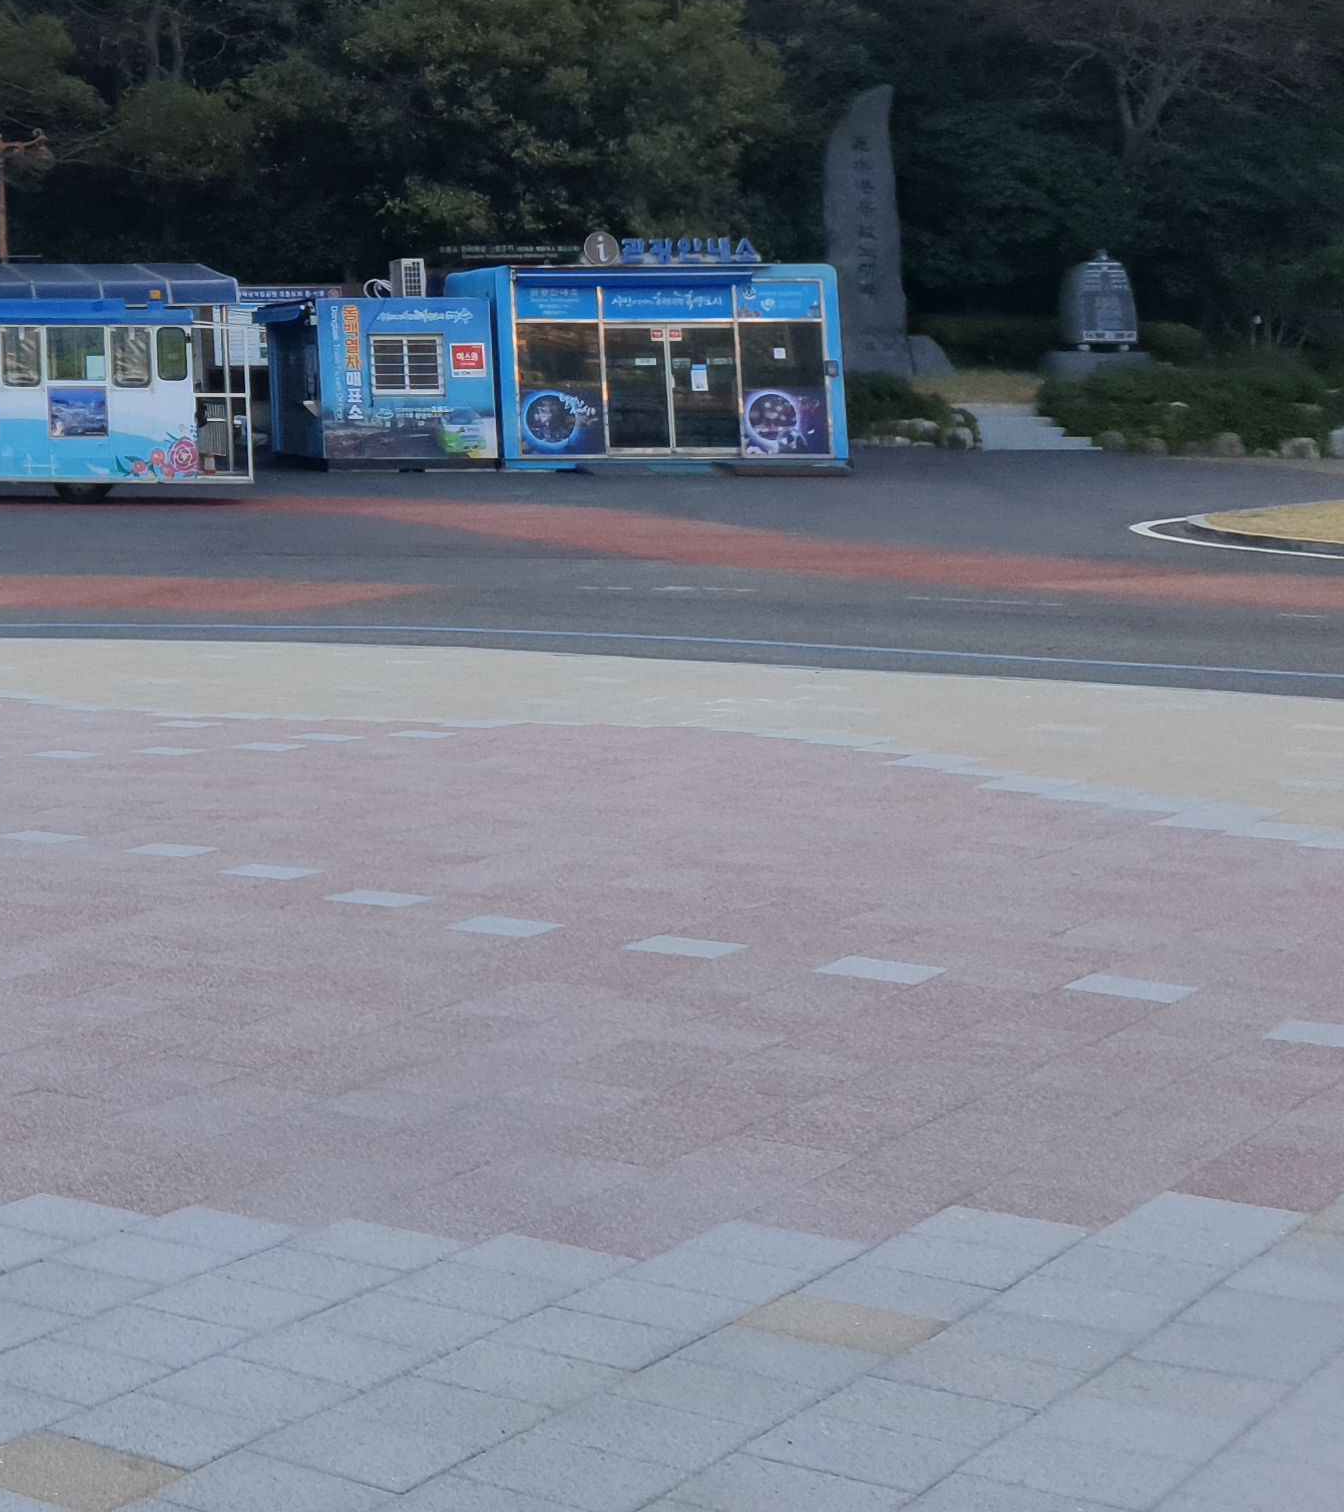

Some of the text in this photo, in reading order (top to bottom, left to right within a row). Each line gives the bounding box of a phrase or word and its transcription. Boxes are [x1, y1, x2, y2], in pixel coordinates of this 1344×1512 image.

[621, 237, 761, 264] 관광안내소
[342, 304, 364, 420] 동백열차 매표소
